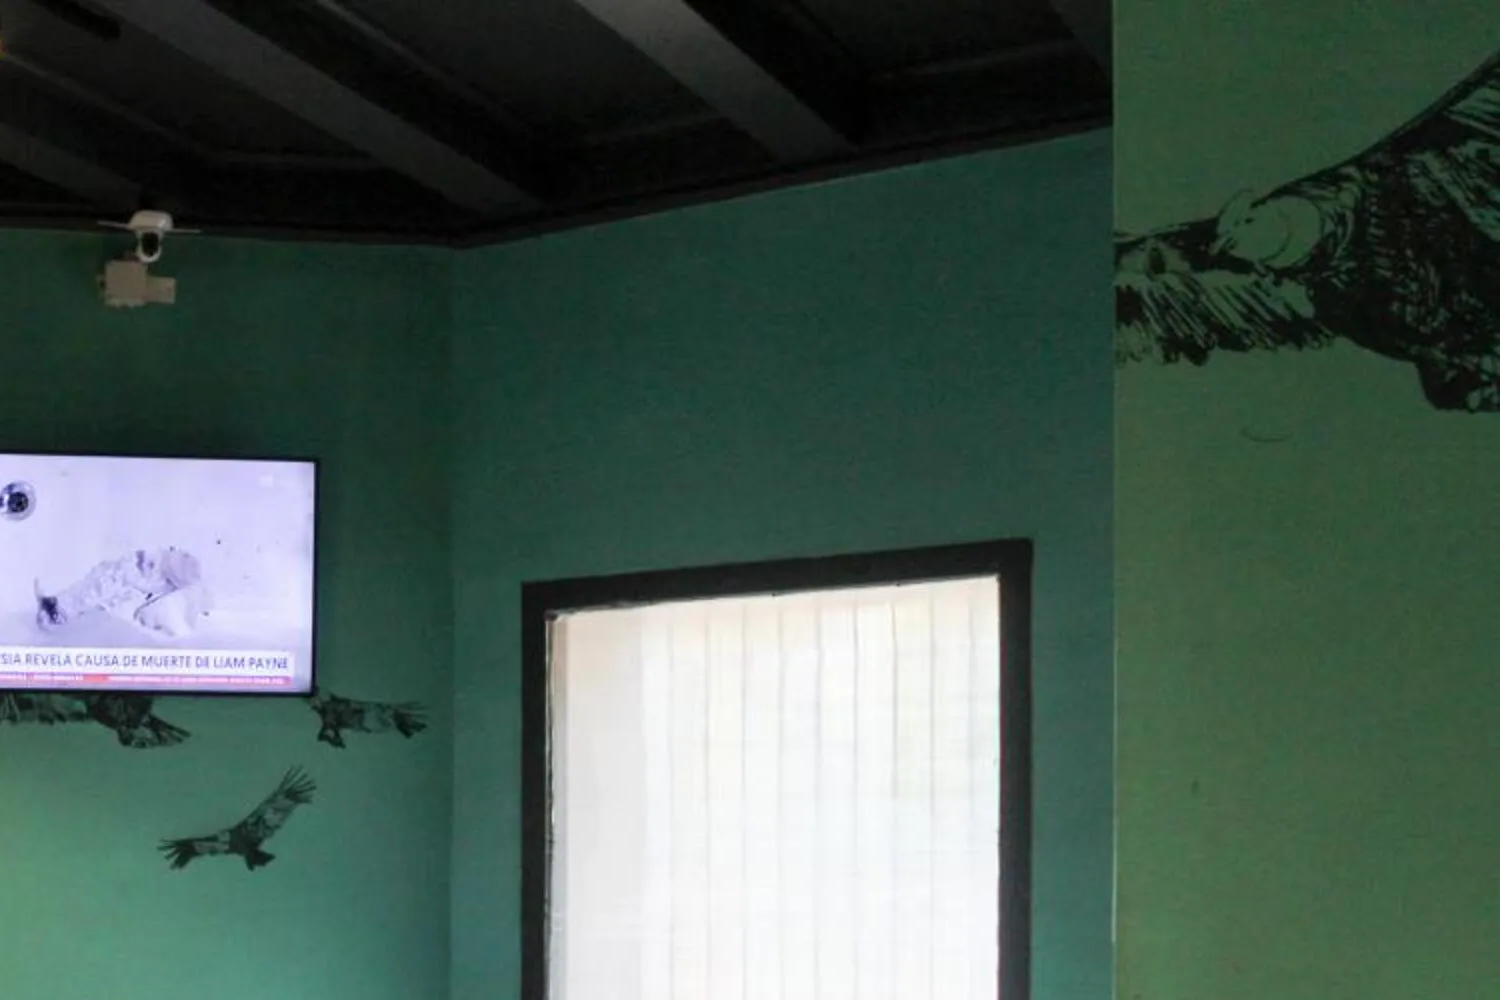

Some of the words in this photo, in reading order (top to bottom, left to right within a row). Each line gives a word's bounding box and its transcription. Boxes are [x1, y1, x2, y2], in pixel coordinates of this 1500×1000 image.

[25, 653, 71, 666] REVELA
[75, 654, 119, 666] CAUSA
[123, 655, 138, 667] DE
[141, 655, 190, 669] MUERTE
[195, 656, 209, 669] DE
[213, 656, 245, 669] LIAM
[248, 656, 288, 669] PAYNE
